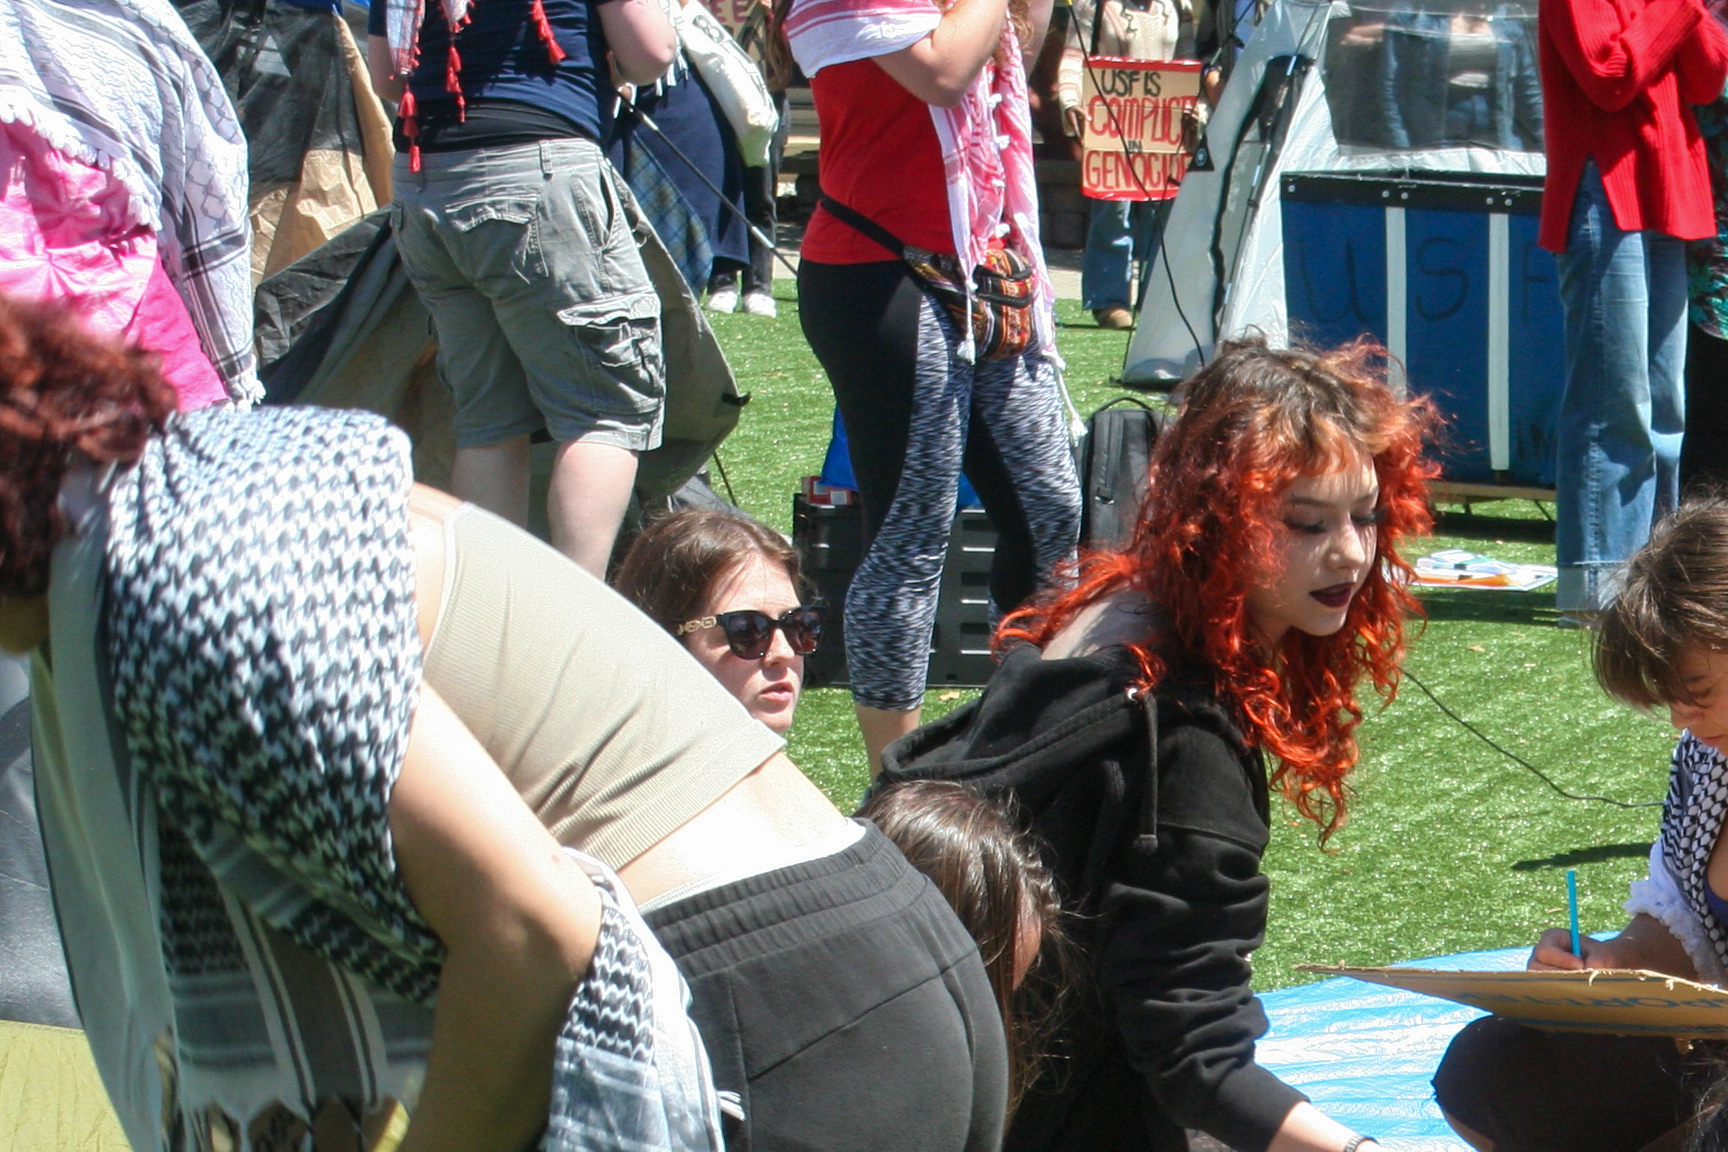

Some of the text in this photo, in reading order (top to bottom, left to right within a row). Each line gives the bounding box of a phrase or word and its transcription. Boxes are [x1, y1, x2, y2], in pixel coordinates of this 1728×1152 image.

[1101, 69, 1161, 96] USF IS
[1127, 140, 1142, 153] IN
